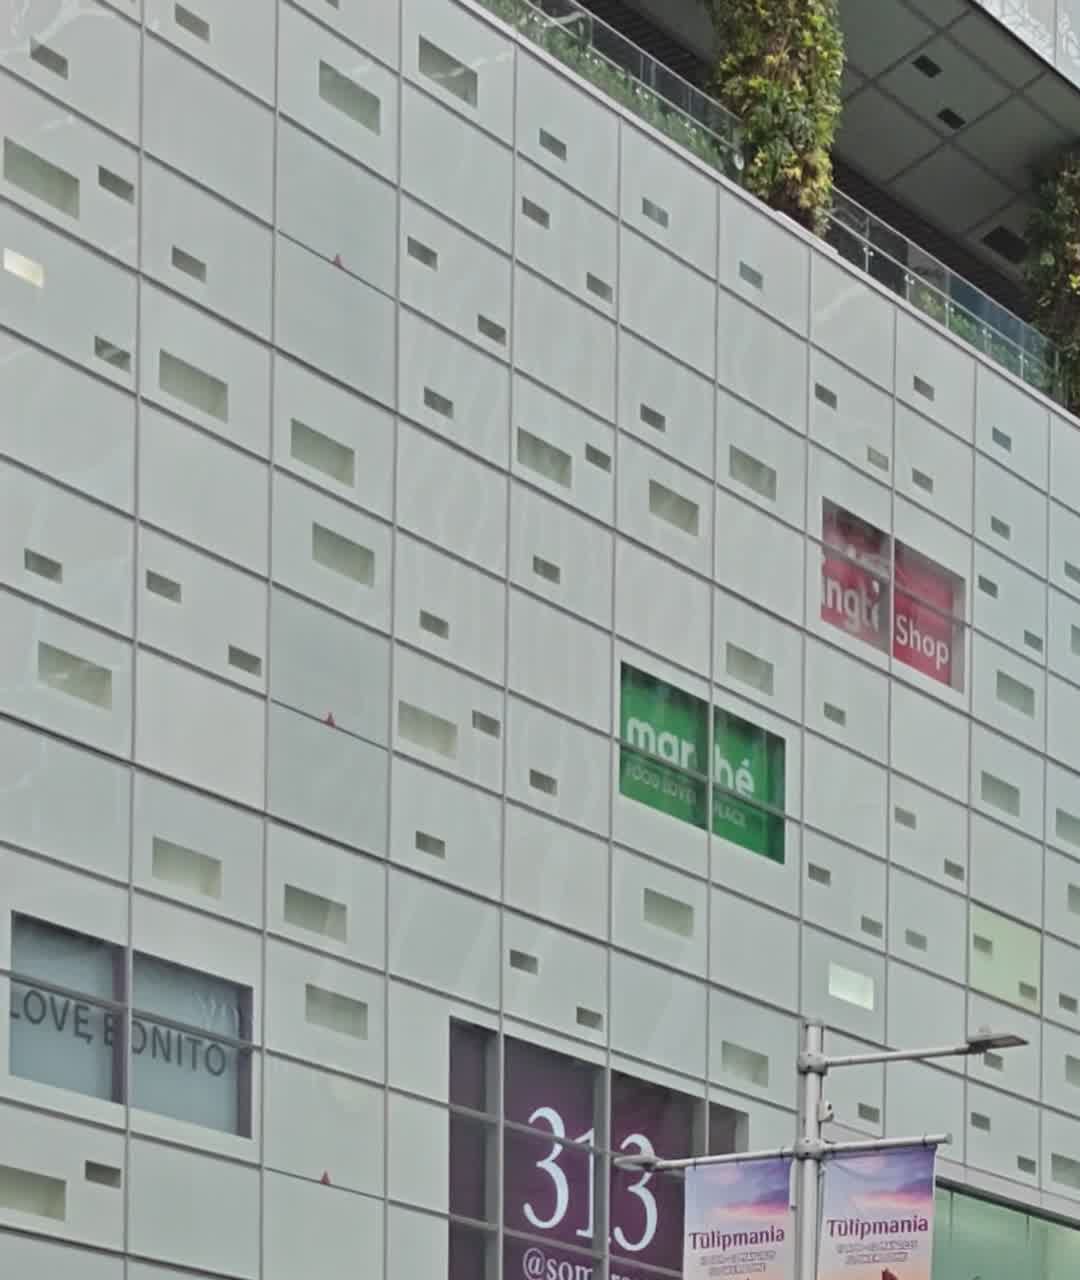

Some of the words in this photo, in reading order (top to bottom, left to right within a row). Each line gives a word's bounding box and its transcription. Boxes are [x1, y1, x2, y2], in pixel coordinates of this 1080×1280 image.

[896, 615, 949, 671] Shop
[626, 717, 756, 800] marhé
[523, 1107, 658, 1252] 313
[688, 1225, 787, 1251] Tulipmania
[823, 1214, 930, 1241] Tulipmania
